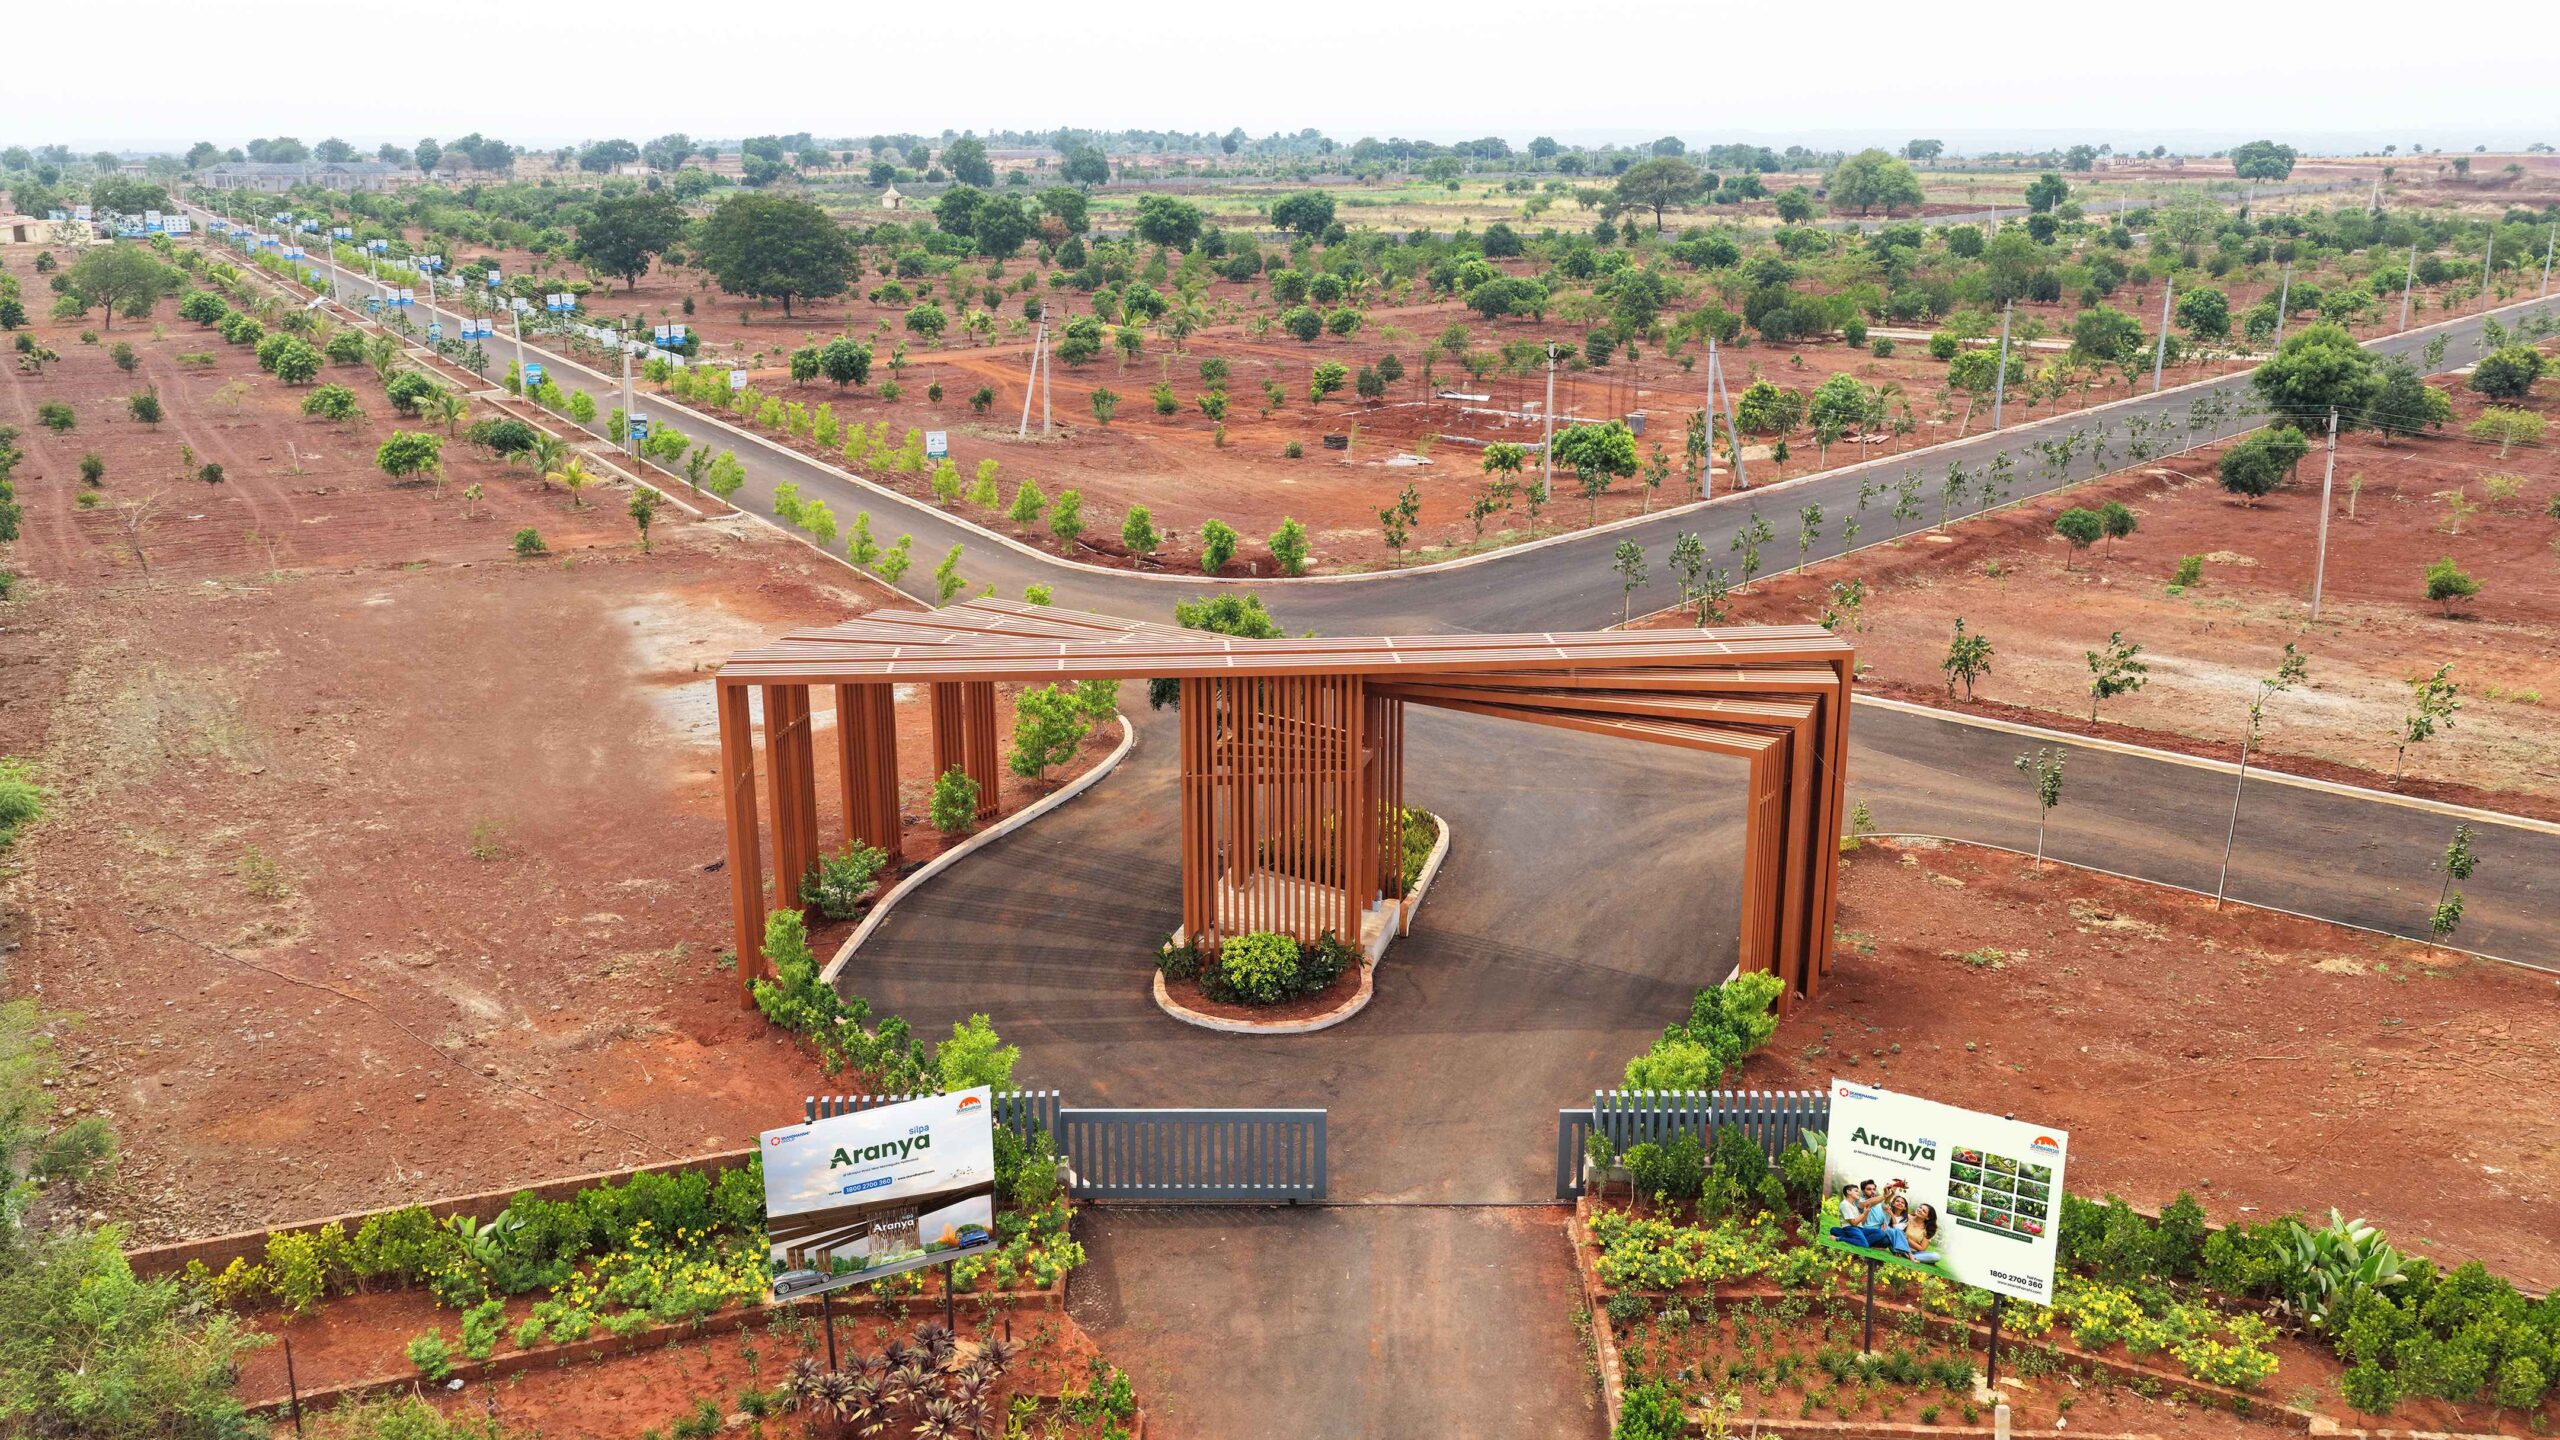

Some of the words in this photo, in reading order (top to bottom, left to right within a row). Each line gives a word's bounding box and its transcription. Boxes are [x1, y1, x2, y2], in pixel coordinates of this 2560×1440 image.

[909, 1125, 930, 1135] silpa
[1850, 1126, 1936, 1161] Aranya
[1918, 1138, 1937, 1147] silpa
[830, 1133, 931, 1169] Aranya
[846, 1185, 862, 1193] 1800
[862, 1181, 878, 1190] 2700
[873, 1219, 915, 1233] Aranya
[1990, 1269, 2008, 1279] 1800
[2008, 1274, 2027, 1285] 2700
[2027, 1280, 2043, 1289] 360
